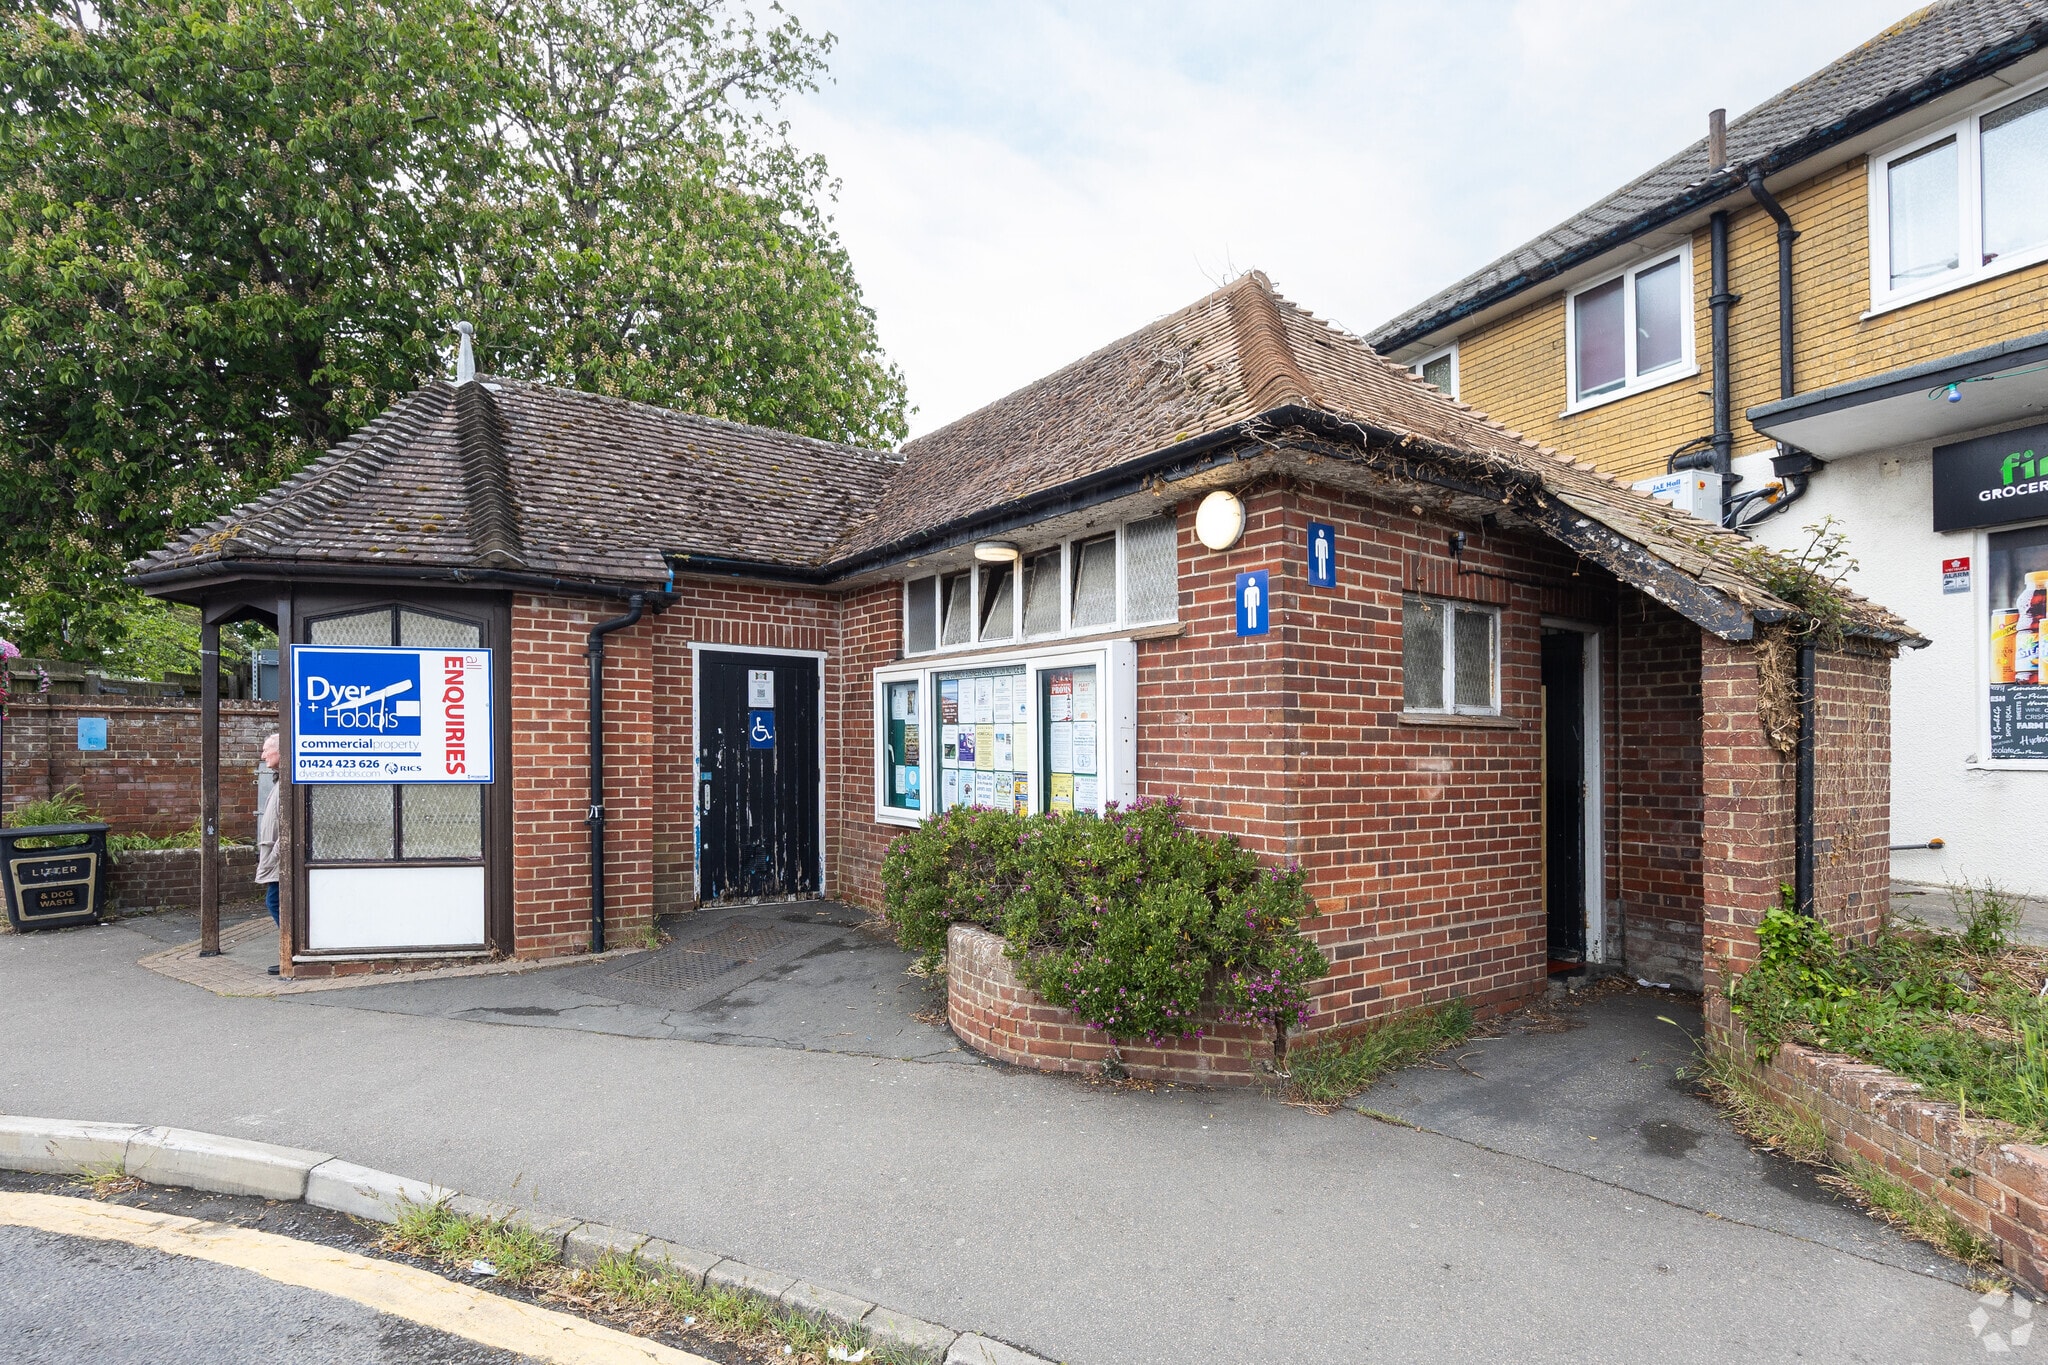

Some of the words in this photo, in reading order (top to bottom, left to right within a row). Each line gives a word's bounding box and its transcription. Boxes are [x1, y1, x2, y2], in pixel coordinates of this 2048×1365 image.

[1943, 571, 1970, 579] ALARM
[465, 655, 482, 670] all
[307, 676, 371, 707] Dyer
[324, 706, 399, 728] Hobbis
[442, 656, 466, 775] ENQUIRIES
[299, 759, 333, 769] 01424
[335, 759, 356, 769] 423
[358, 759, 380, 769] 626
[299, 769, 381, 779] dyerandhobbis.com
[32, 865, 78, 877] LITTER
[40, 892, 48, 900] &
[51, 890, 74, 899] DOG
[40, 898, 75, 907] WASTE
